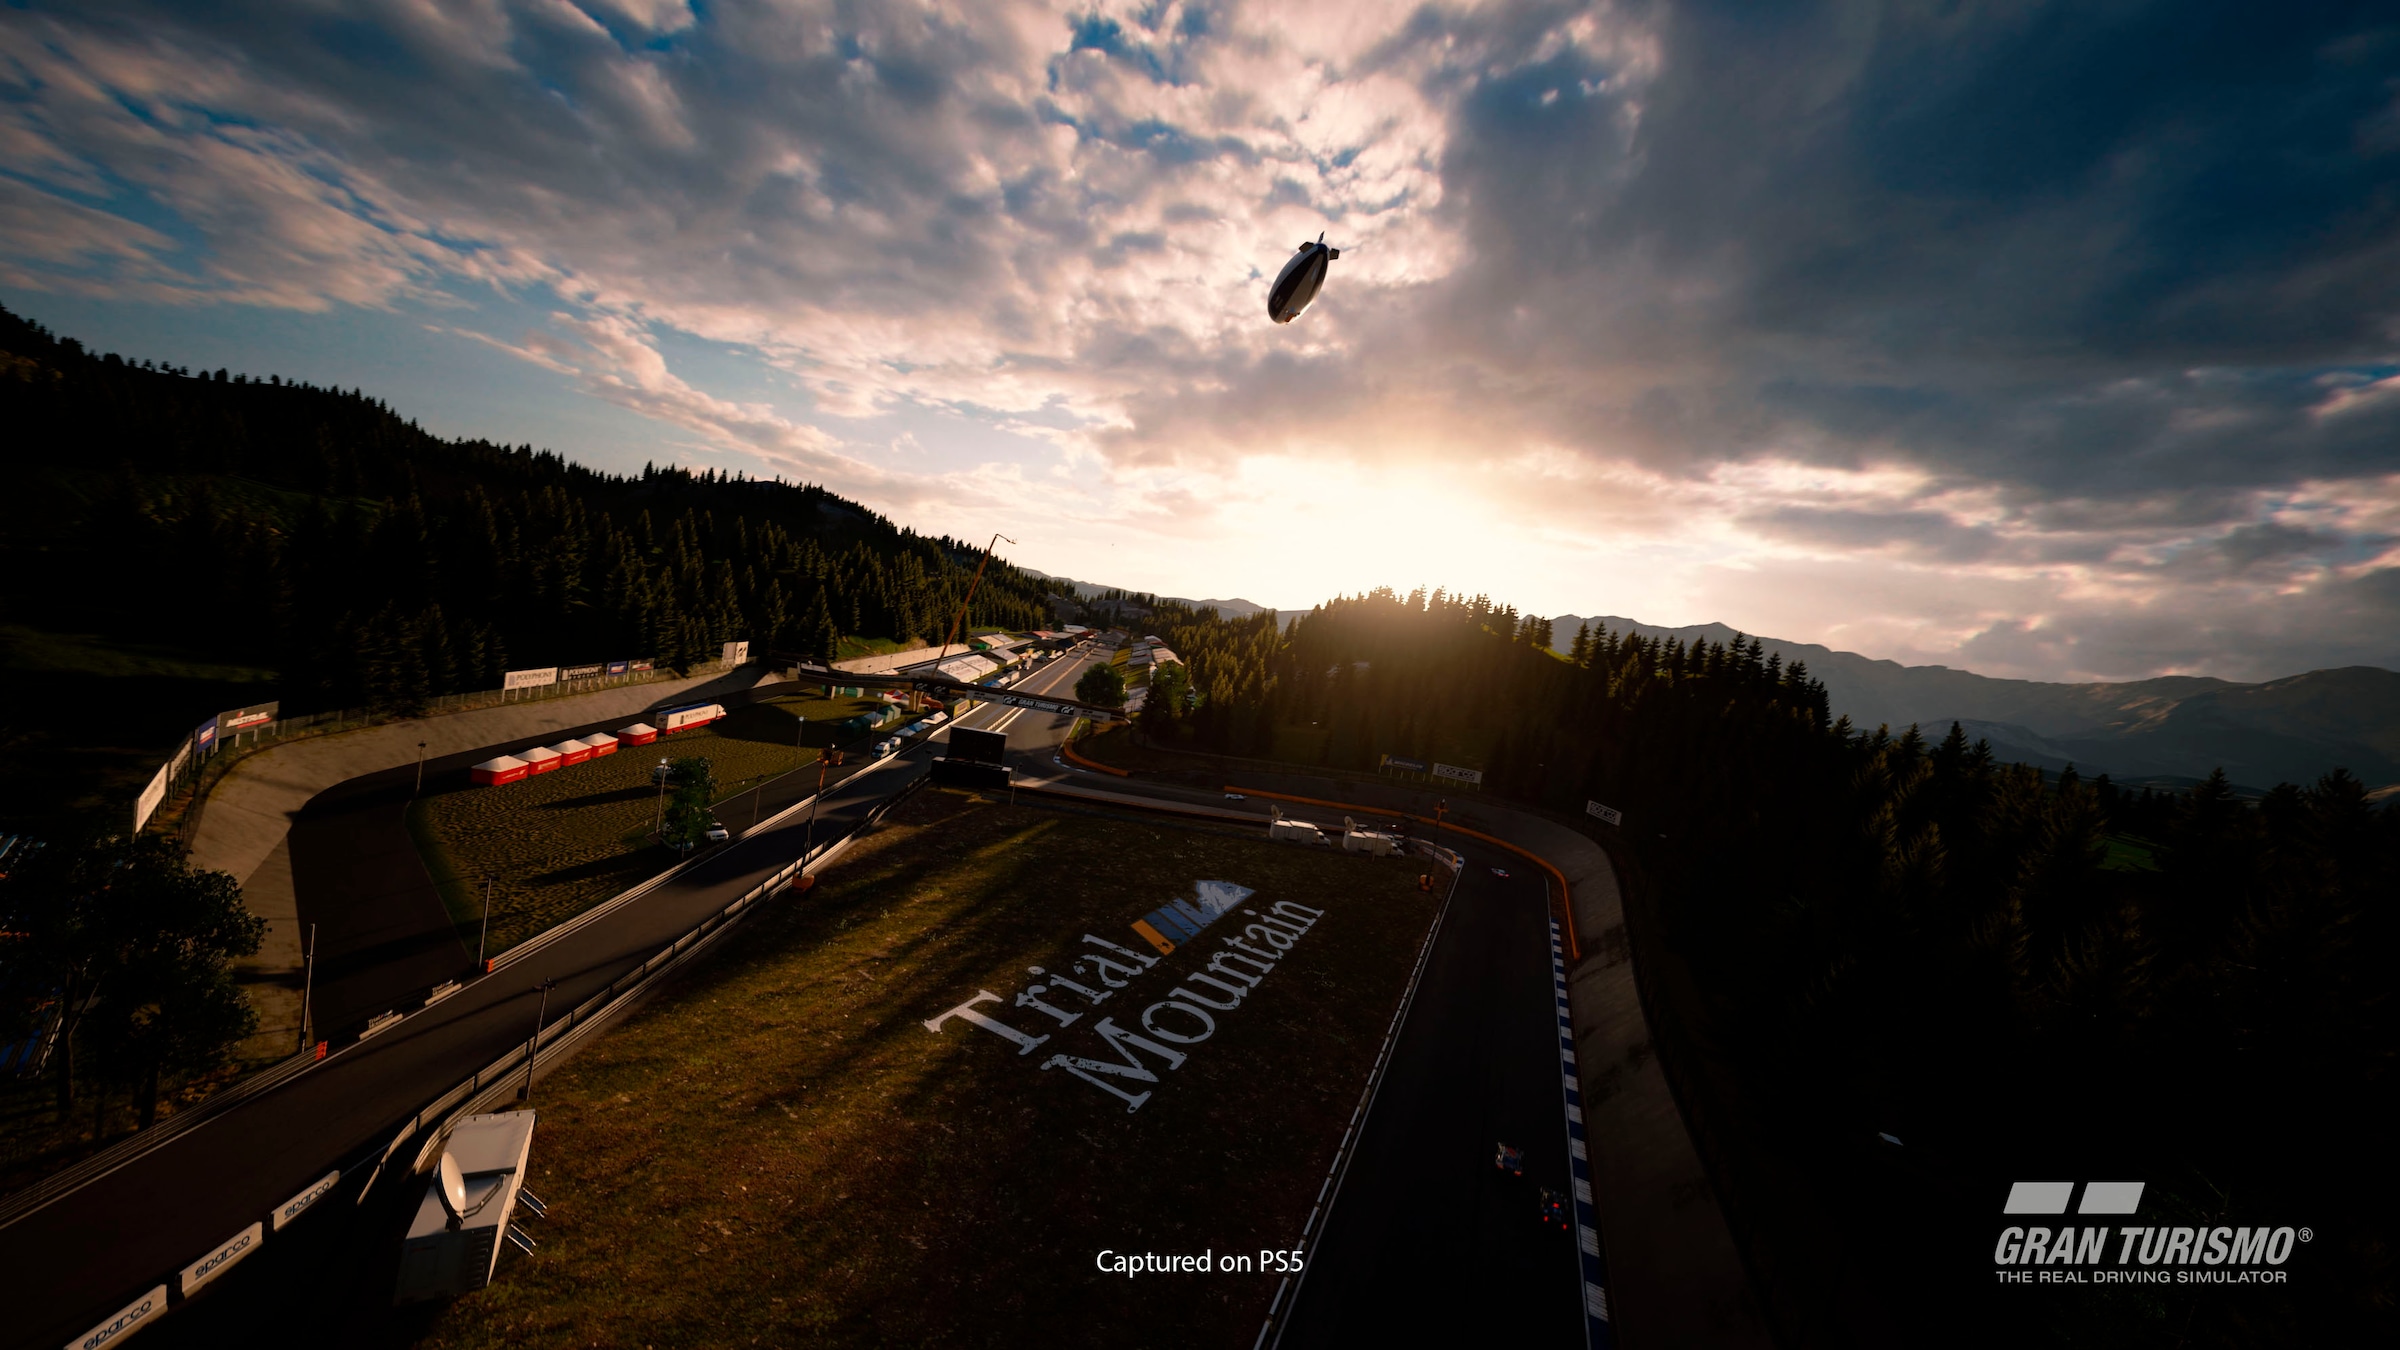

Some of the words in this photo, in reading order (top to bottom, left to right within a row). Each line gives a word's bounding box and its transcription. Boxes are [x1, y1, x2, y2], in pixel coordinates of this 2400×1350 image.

[921, 933, 1162, 1056] Trial
[1040, 898, 1326, 1114] Mountain
[284, 1181, 330, 1219] sparco
[195, 1235, 250, 1279] sparco
[83, 1300, 152, 1350] sparco
